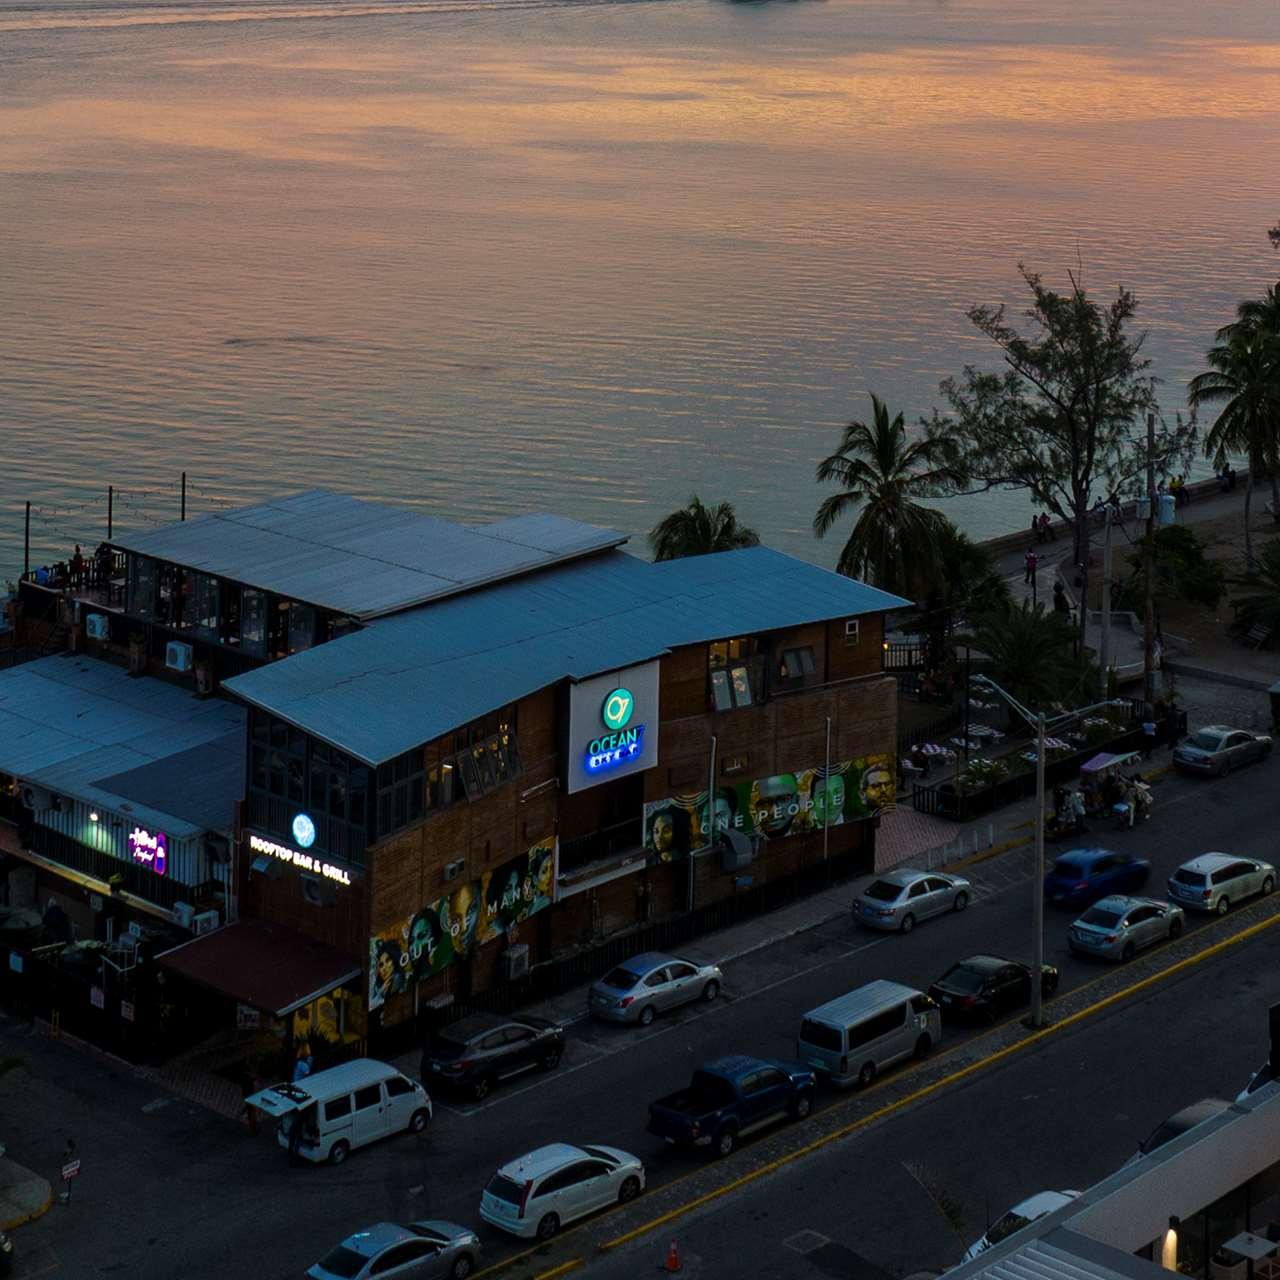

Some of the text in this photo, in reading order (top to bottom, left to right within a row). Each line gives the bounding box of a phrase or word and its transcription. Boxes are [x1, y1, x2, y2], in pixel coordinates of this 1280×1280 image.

[700, 793, 843, 835] ONE PEOPLE
[250, 835, 351, 886] ROOFTOP BAR & GRILL
[400, 878, 532, 967] OUT OF MANY
